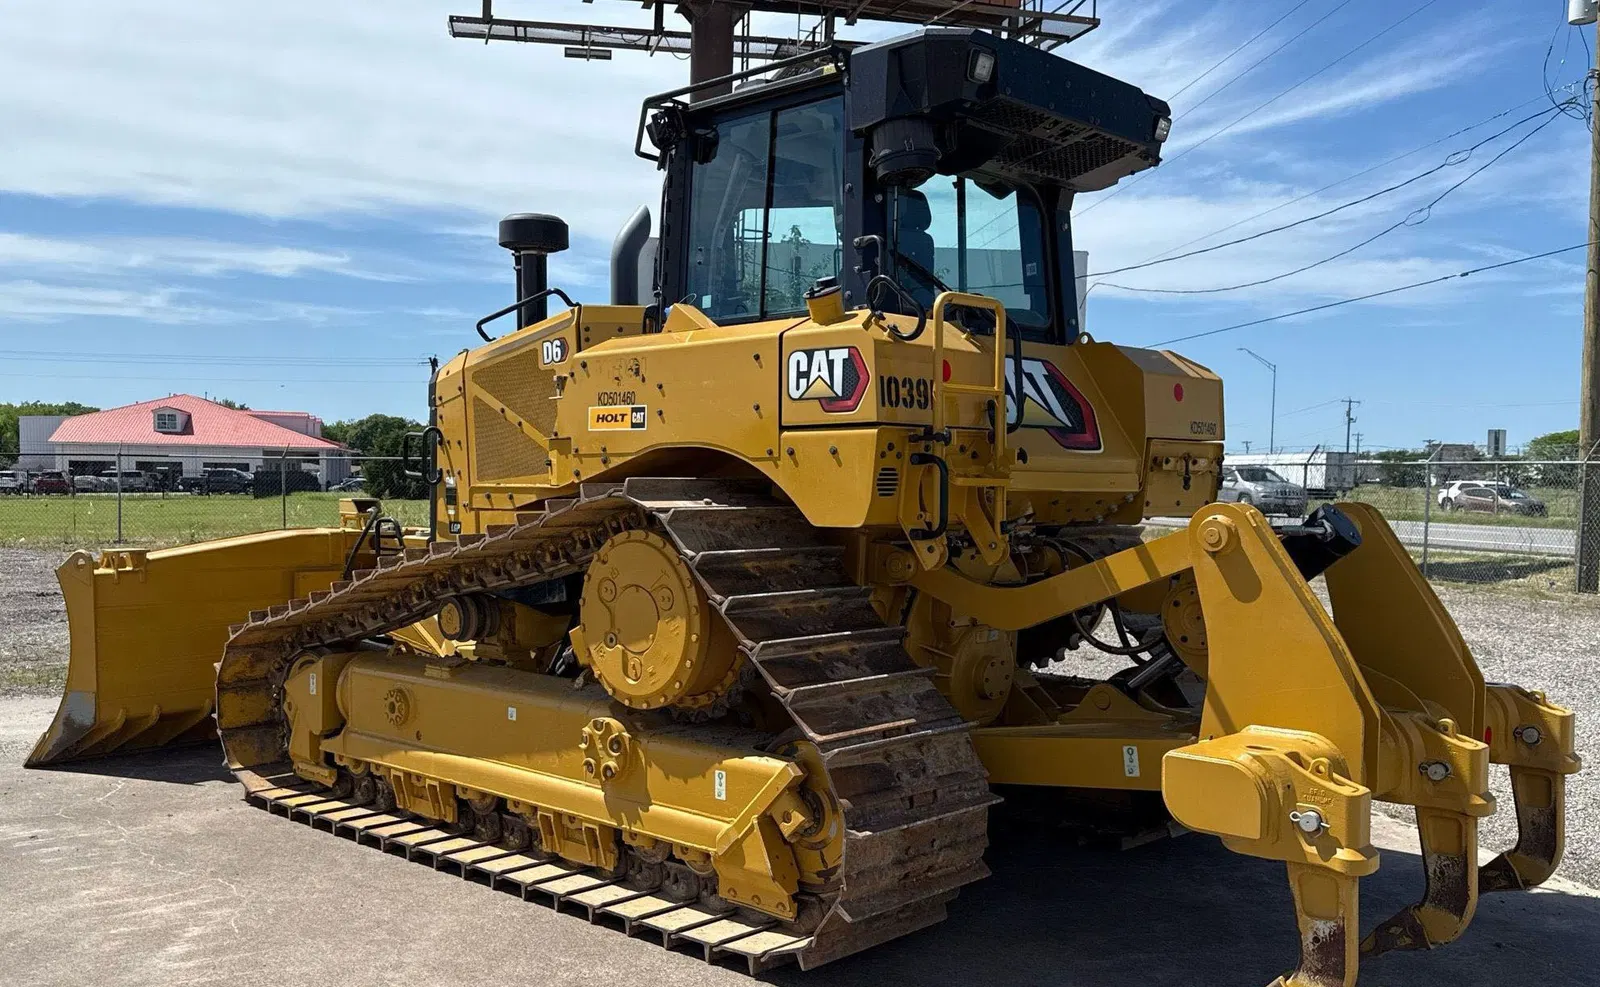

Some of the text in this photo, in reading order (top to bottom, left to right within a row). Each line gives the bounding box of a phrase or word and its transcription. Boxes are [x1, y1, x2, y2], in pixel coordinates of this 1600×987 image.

[543, 339, 561, 364] D6
[788, 348, 849, 399] CAT
[597, 391, 636, 406] KD501460
[879, 375, 934, 410] 1039
[1004, 357, 1073, 428] AT
[596, 411, 645, 423] HOLT CAT
